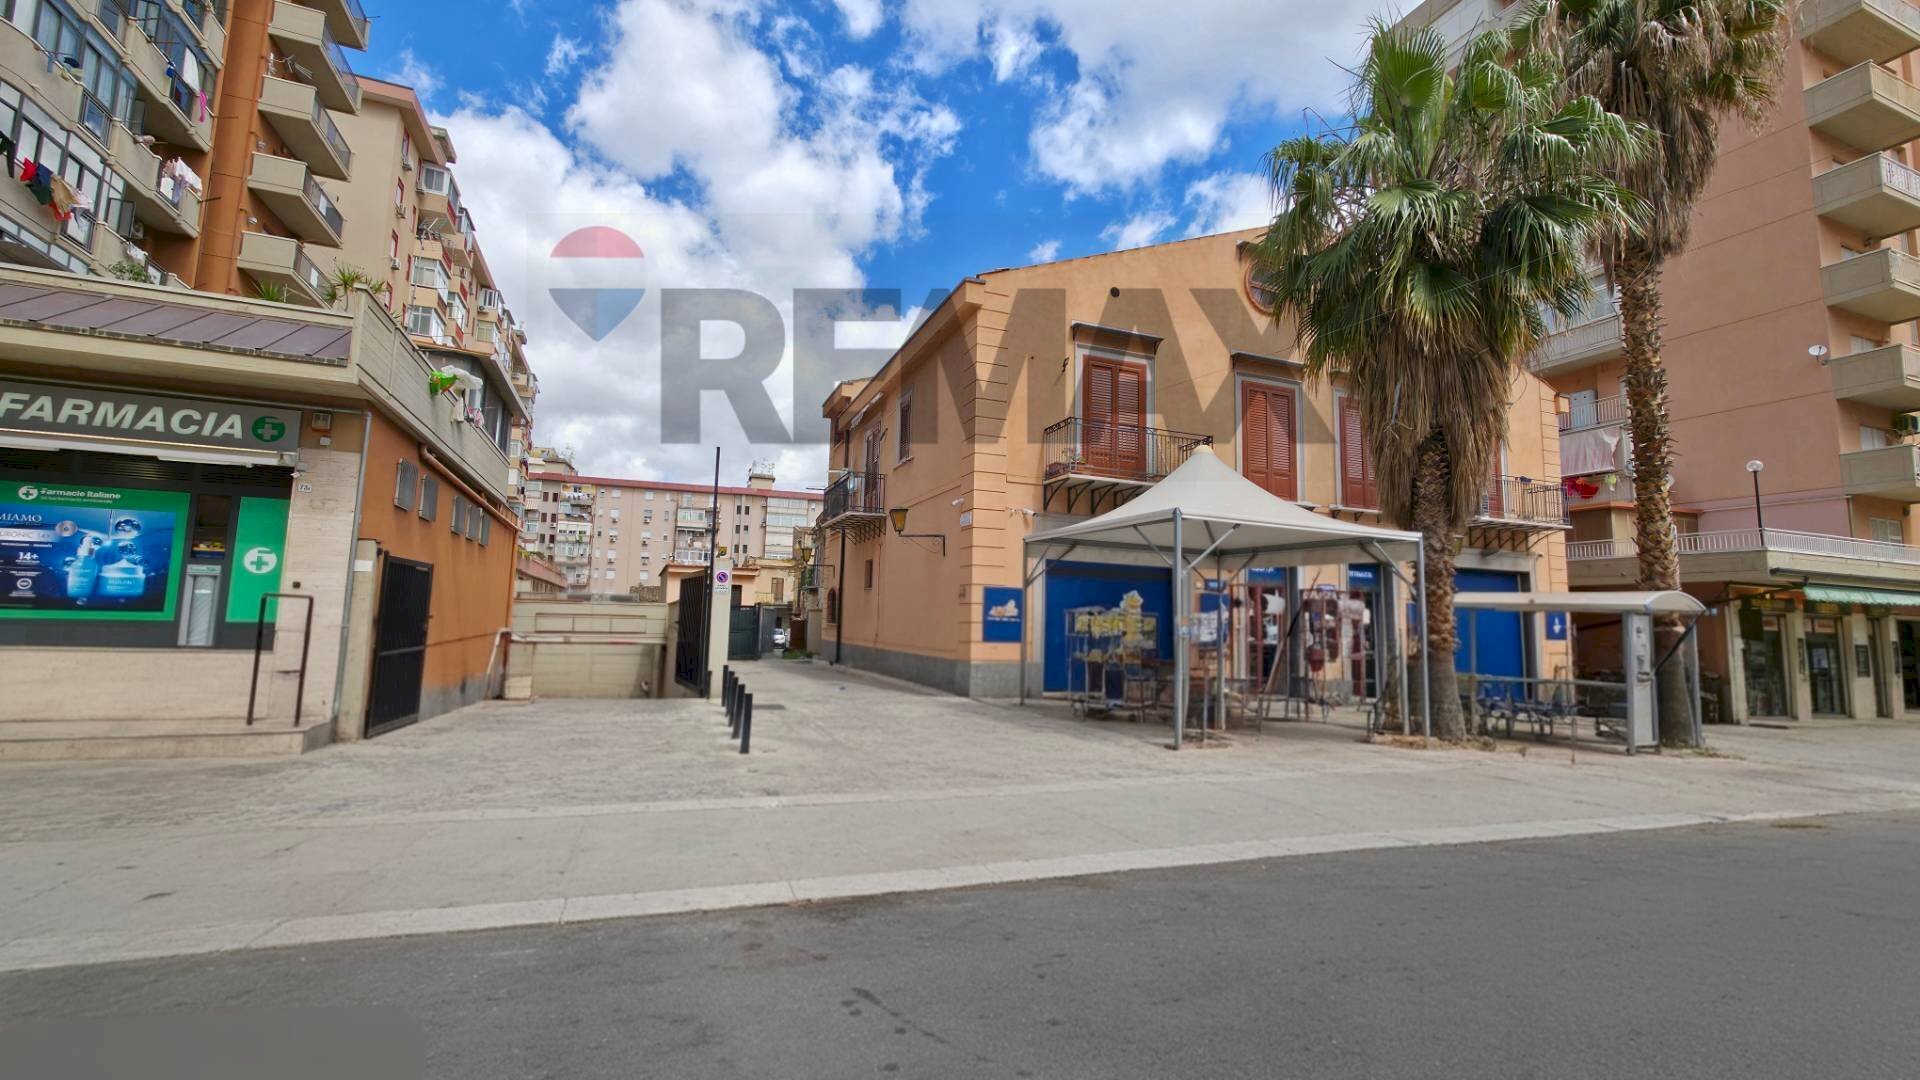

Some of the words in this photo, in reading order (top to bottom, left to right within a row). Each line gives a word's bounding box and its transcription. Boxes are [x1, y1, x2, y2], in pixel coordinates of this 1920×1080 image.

[0, 391, 243, 439] FARMACIA
[40, 487, 85, 497] Farmacie
[87, 490, 121, 500] Italiane
